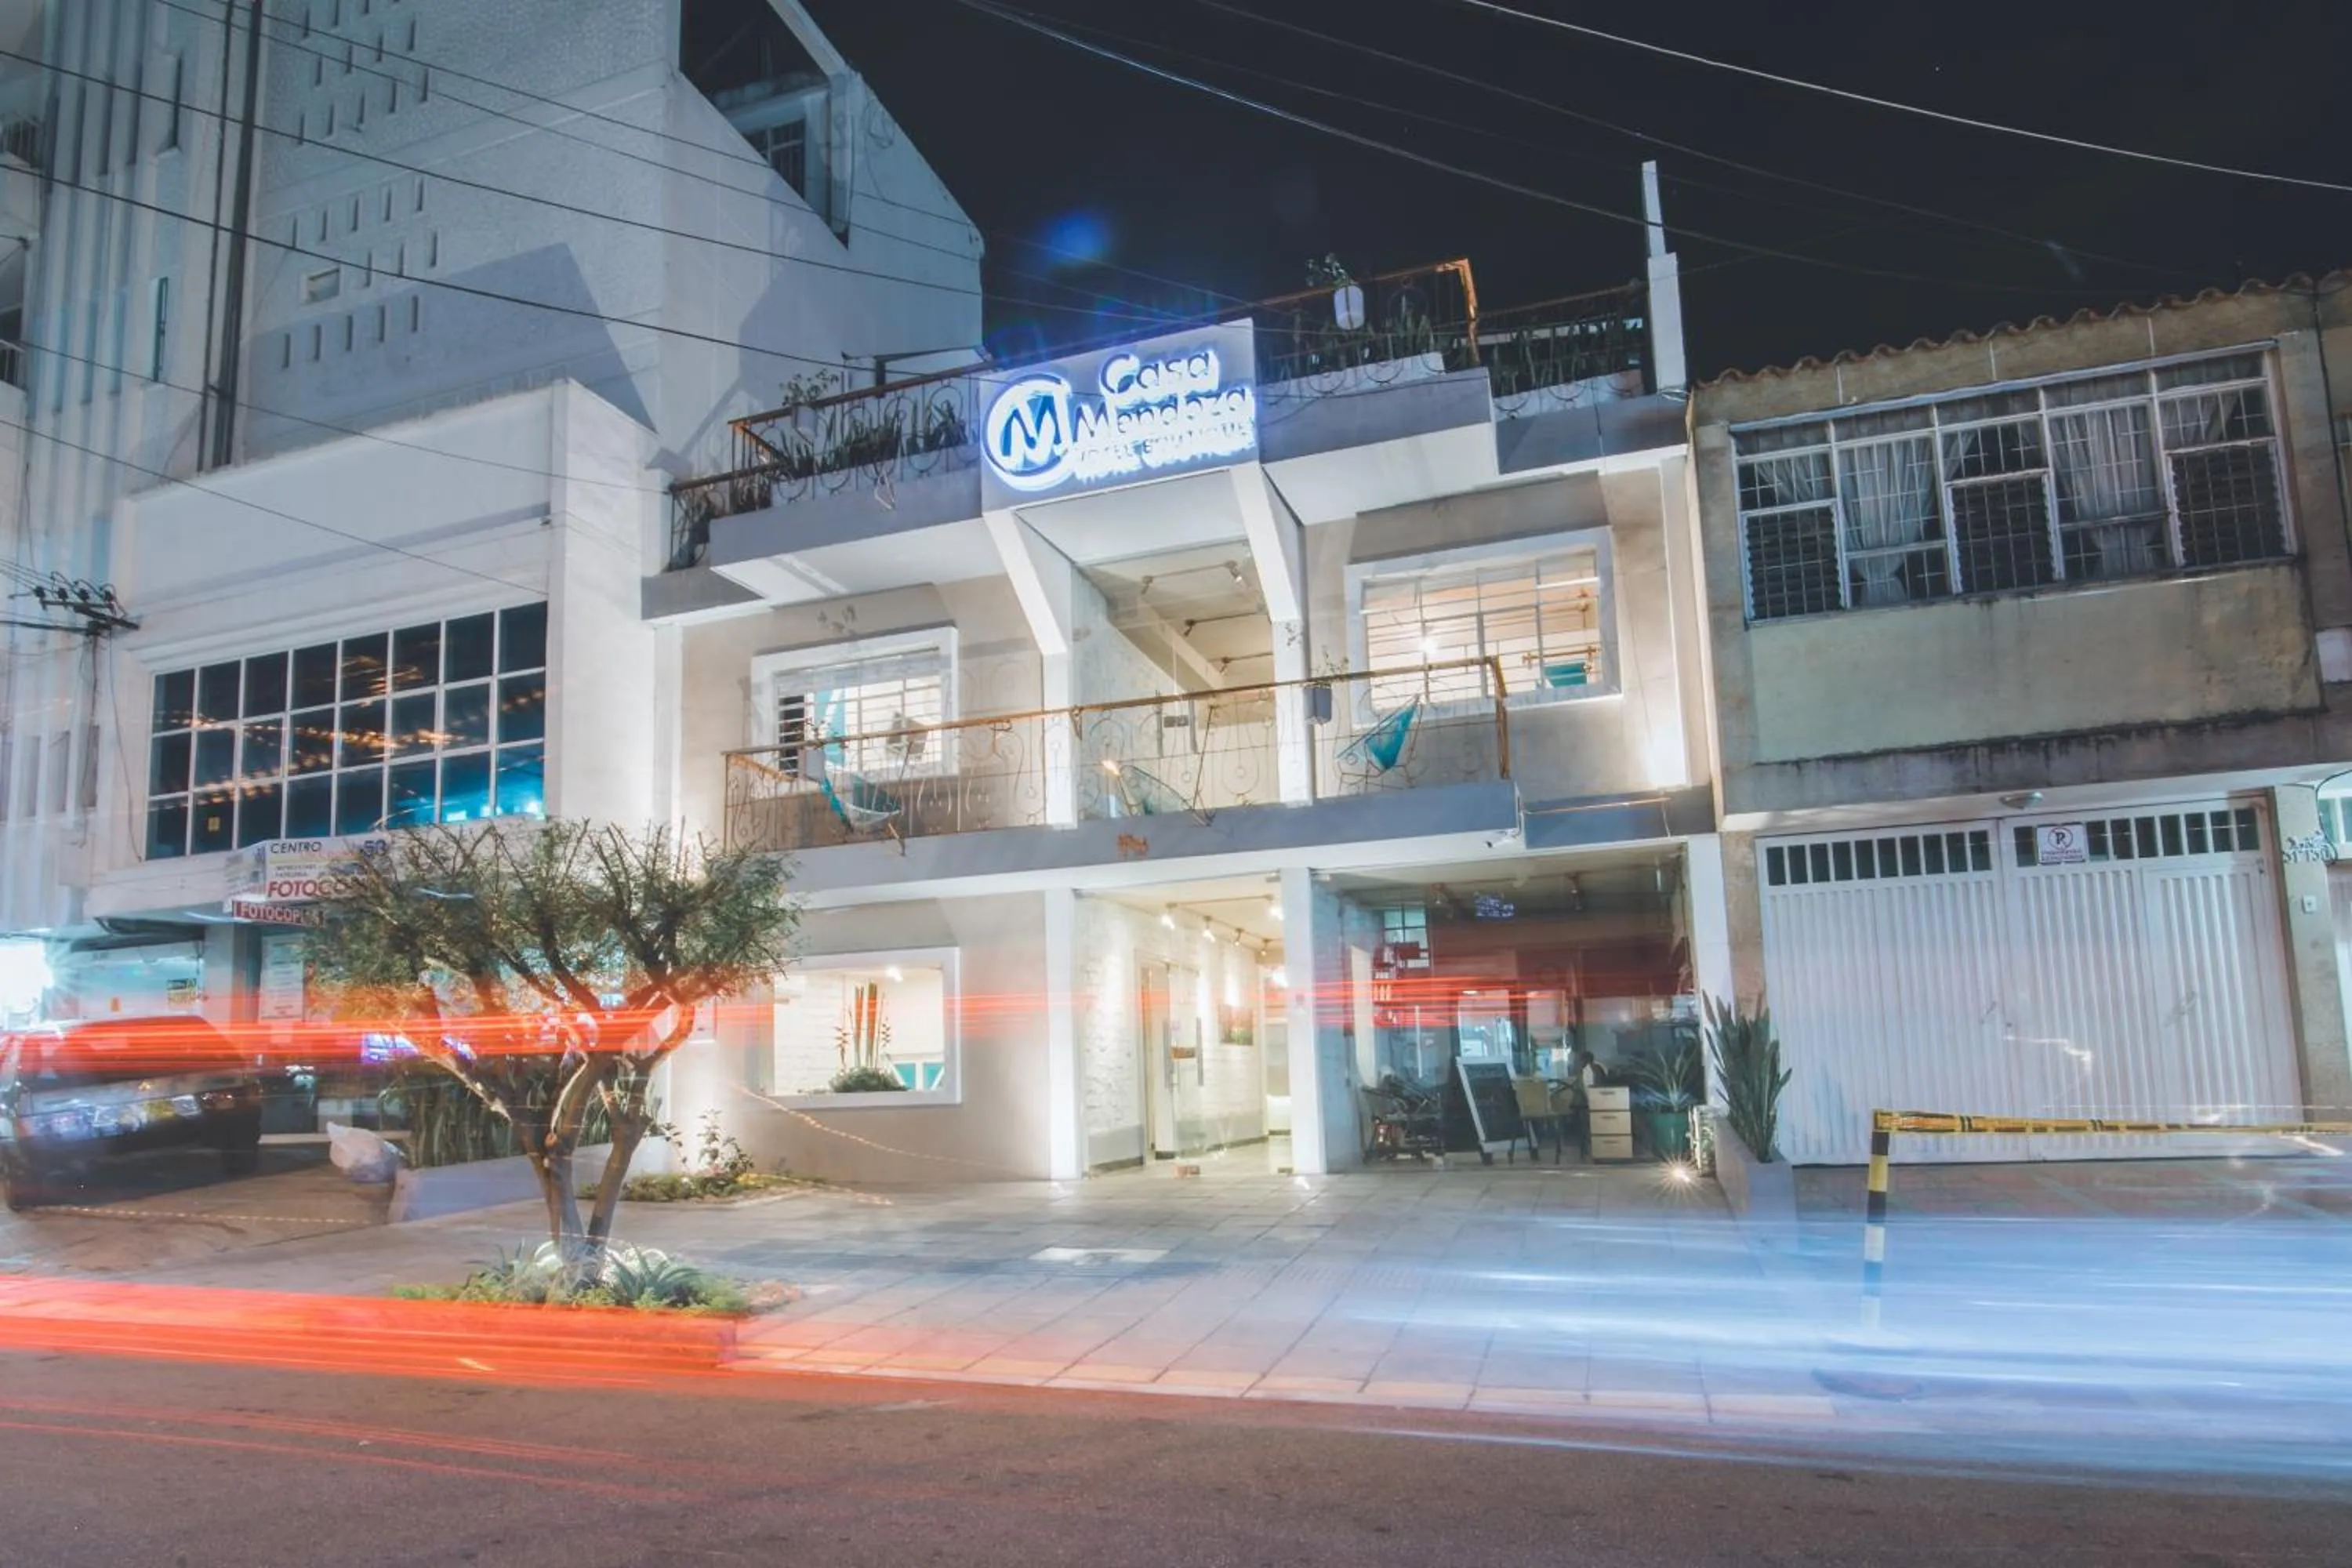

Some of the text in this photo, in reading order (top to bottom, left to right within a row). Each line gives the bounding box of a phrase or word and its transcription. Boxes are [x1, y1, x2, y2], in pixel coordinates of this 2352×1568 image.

[1100, 350, 1214, 394] Casa
[1072, 386, 1250, 443] Mendoza
[270, 841, 322, 854] CENTRO
